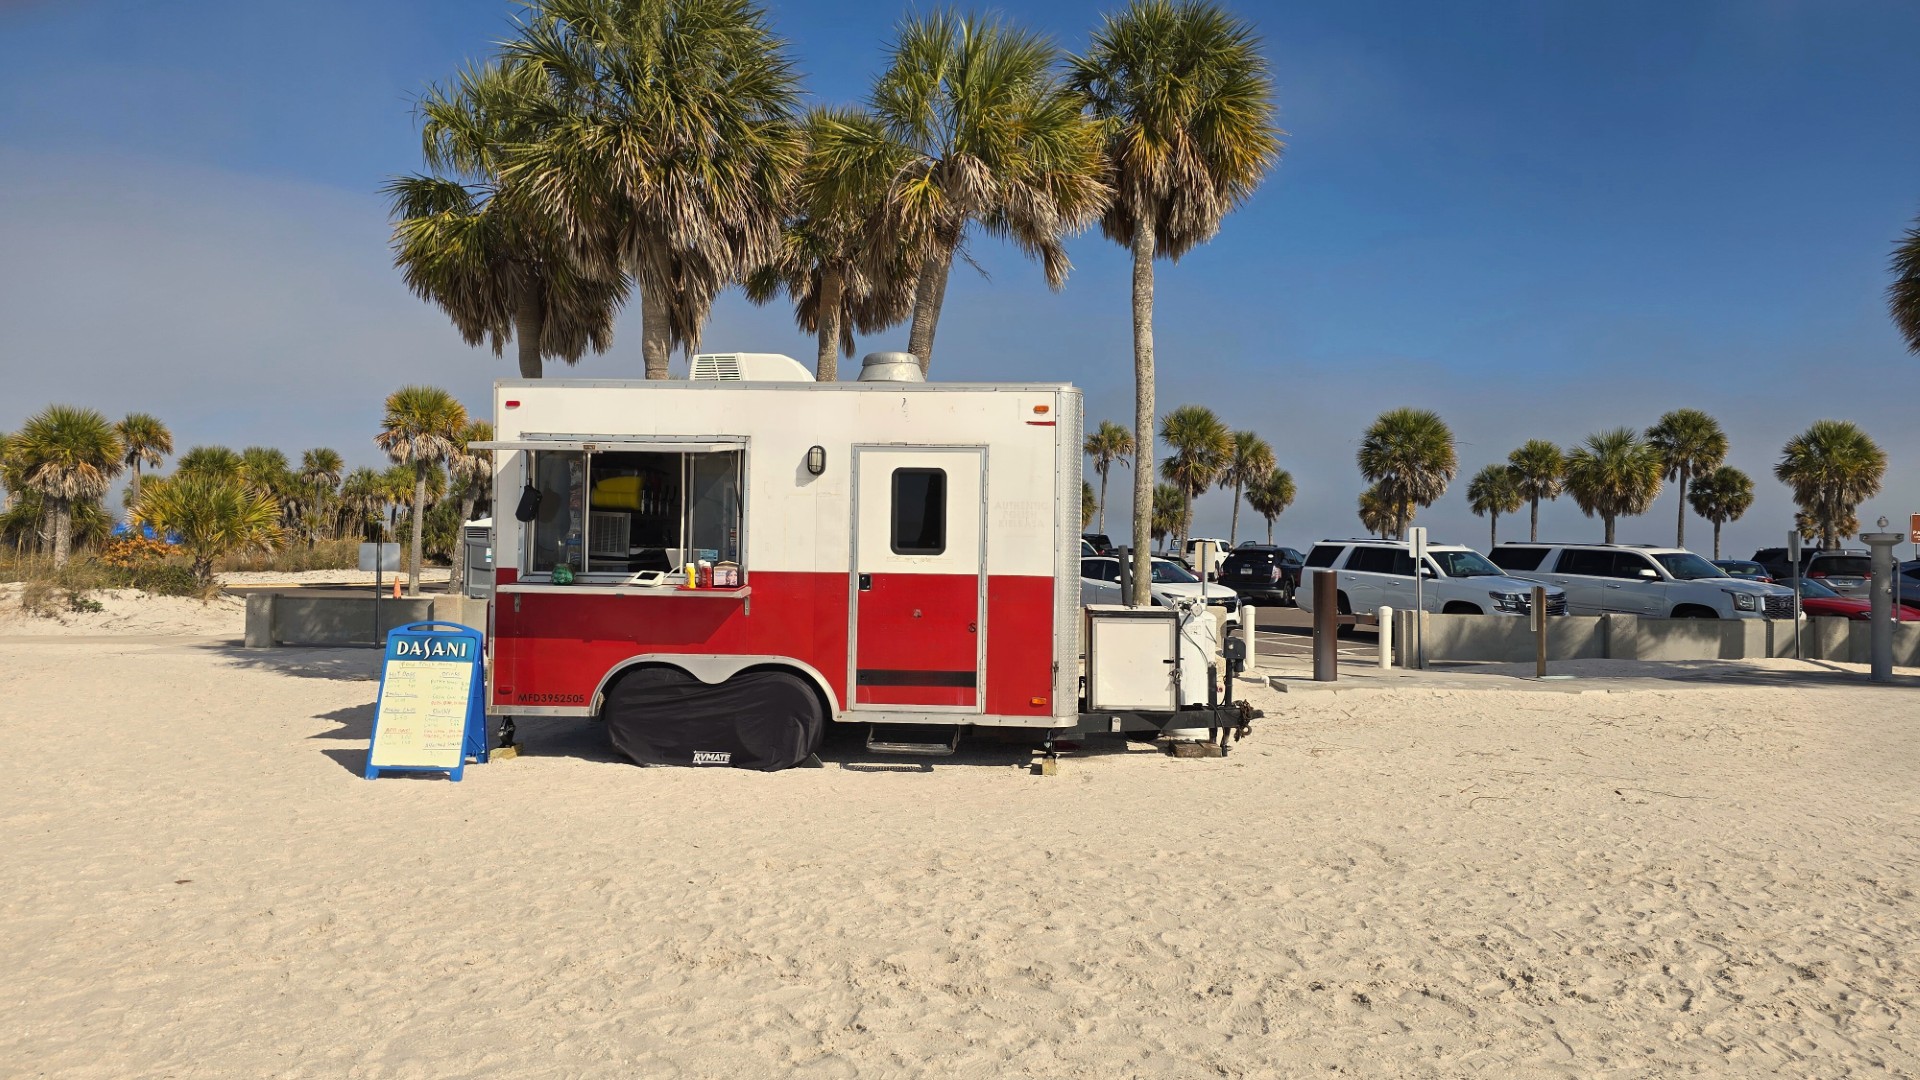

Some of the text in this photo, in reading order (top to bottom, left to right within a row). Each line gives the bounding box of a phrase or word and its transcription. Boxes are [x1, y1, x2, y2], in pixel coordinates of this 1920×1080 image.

[396, 637, 467, 660] DASANI
[517, 693, 585, 703] MFD3952505
[693, 751, 731, 764] RVMATE
